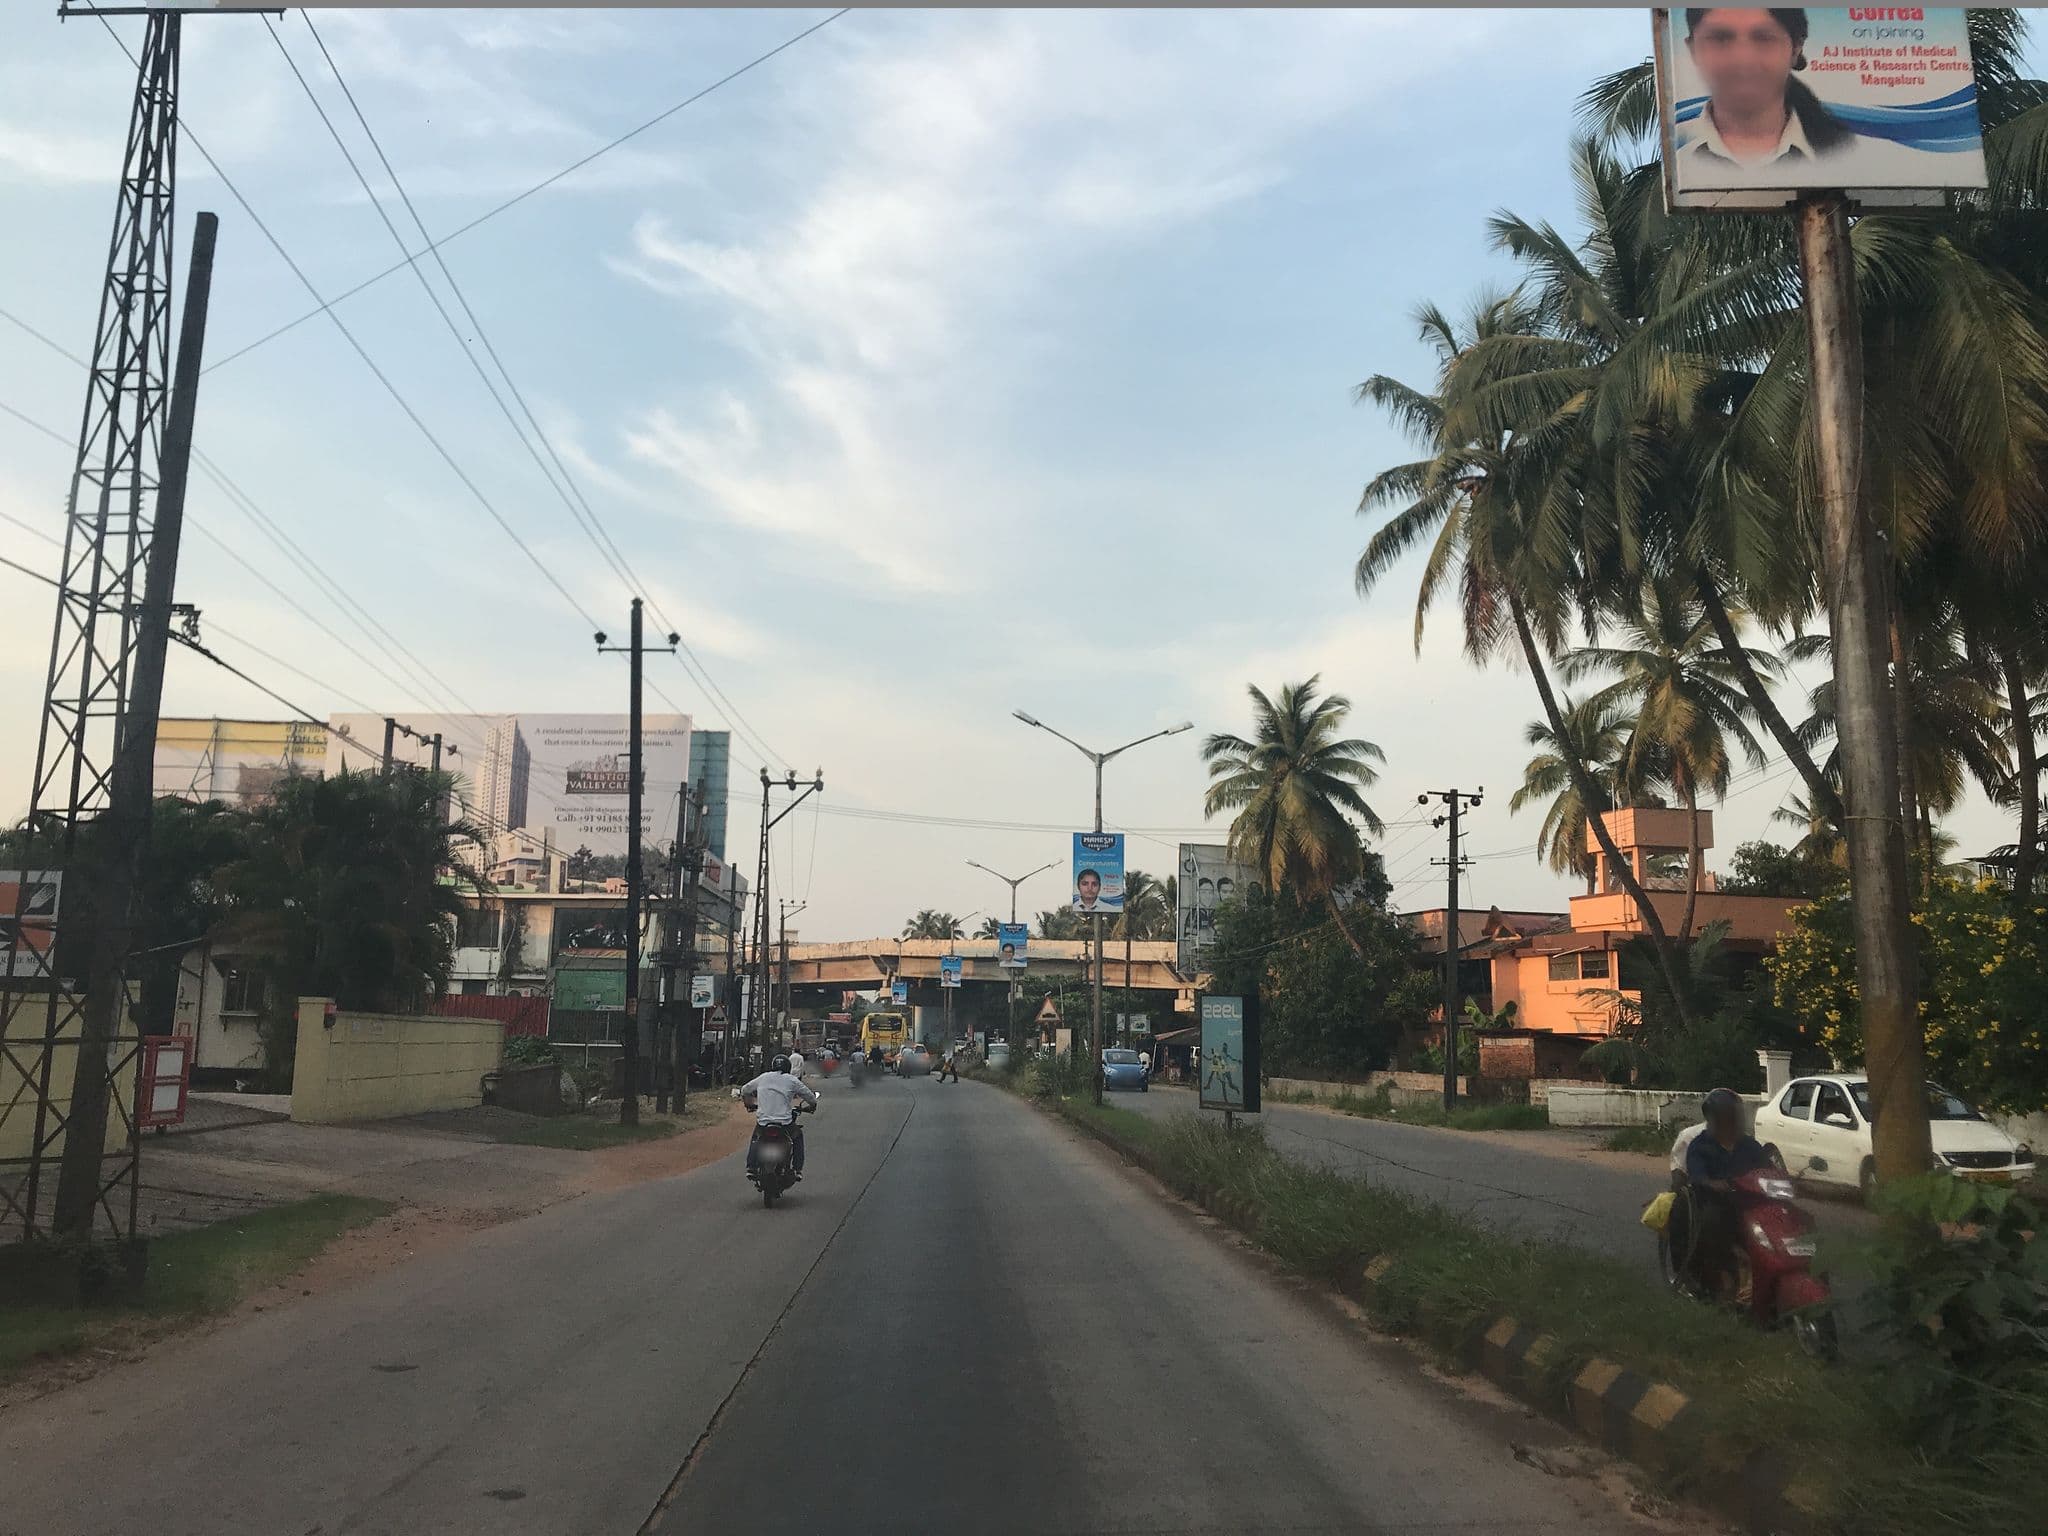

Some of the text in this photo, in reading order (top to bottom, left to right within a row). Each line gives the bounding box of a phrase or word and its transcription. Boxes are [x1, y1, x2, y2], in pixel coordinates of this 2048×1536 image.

[1848, 7, 1924, 22] Correa
[1852, 25, 1925, 41] on joining
[1822, 46, 1957, 58] AJ Institute of Medical
[1811, 60, 1856, 72] Science
[1859, 60, 1871, 72] &
[1873, 60, 1927, 72] Research
[1861, 74, 1925, 88] Mangaluru
[581, 772, 630, 781] PRESTIGE
[569, 780, 607, 789] VALLEY
